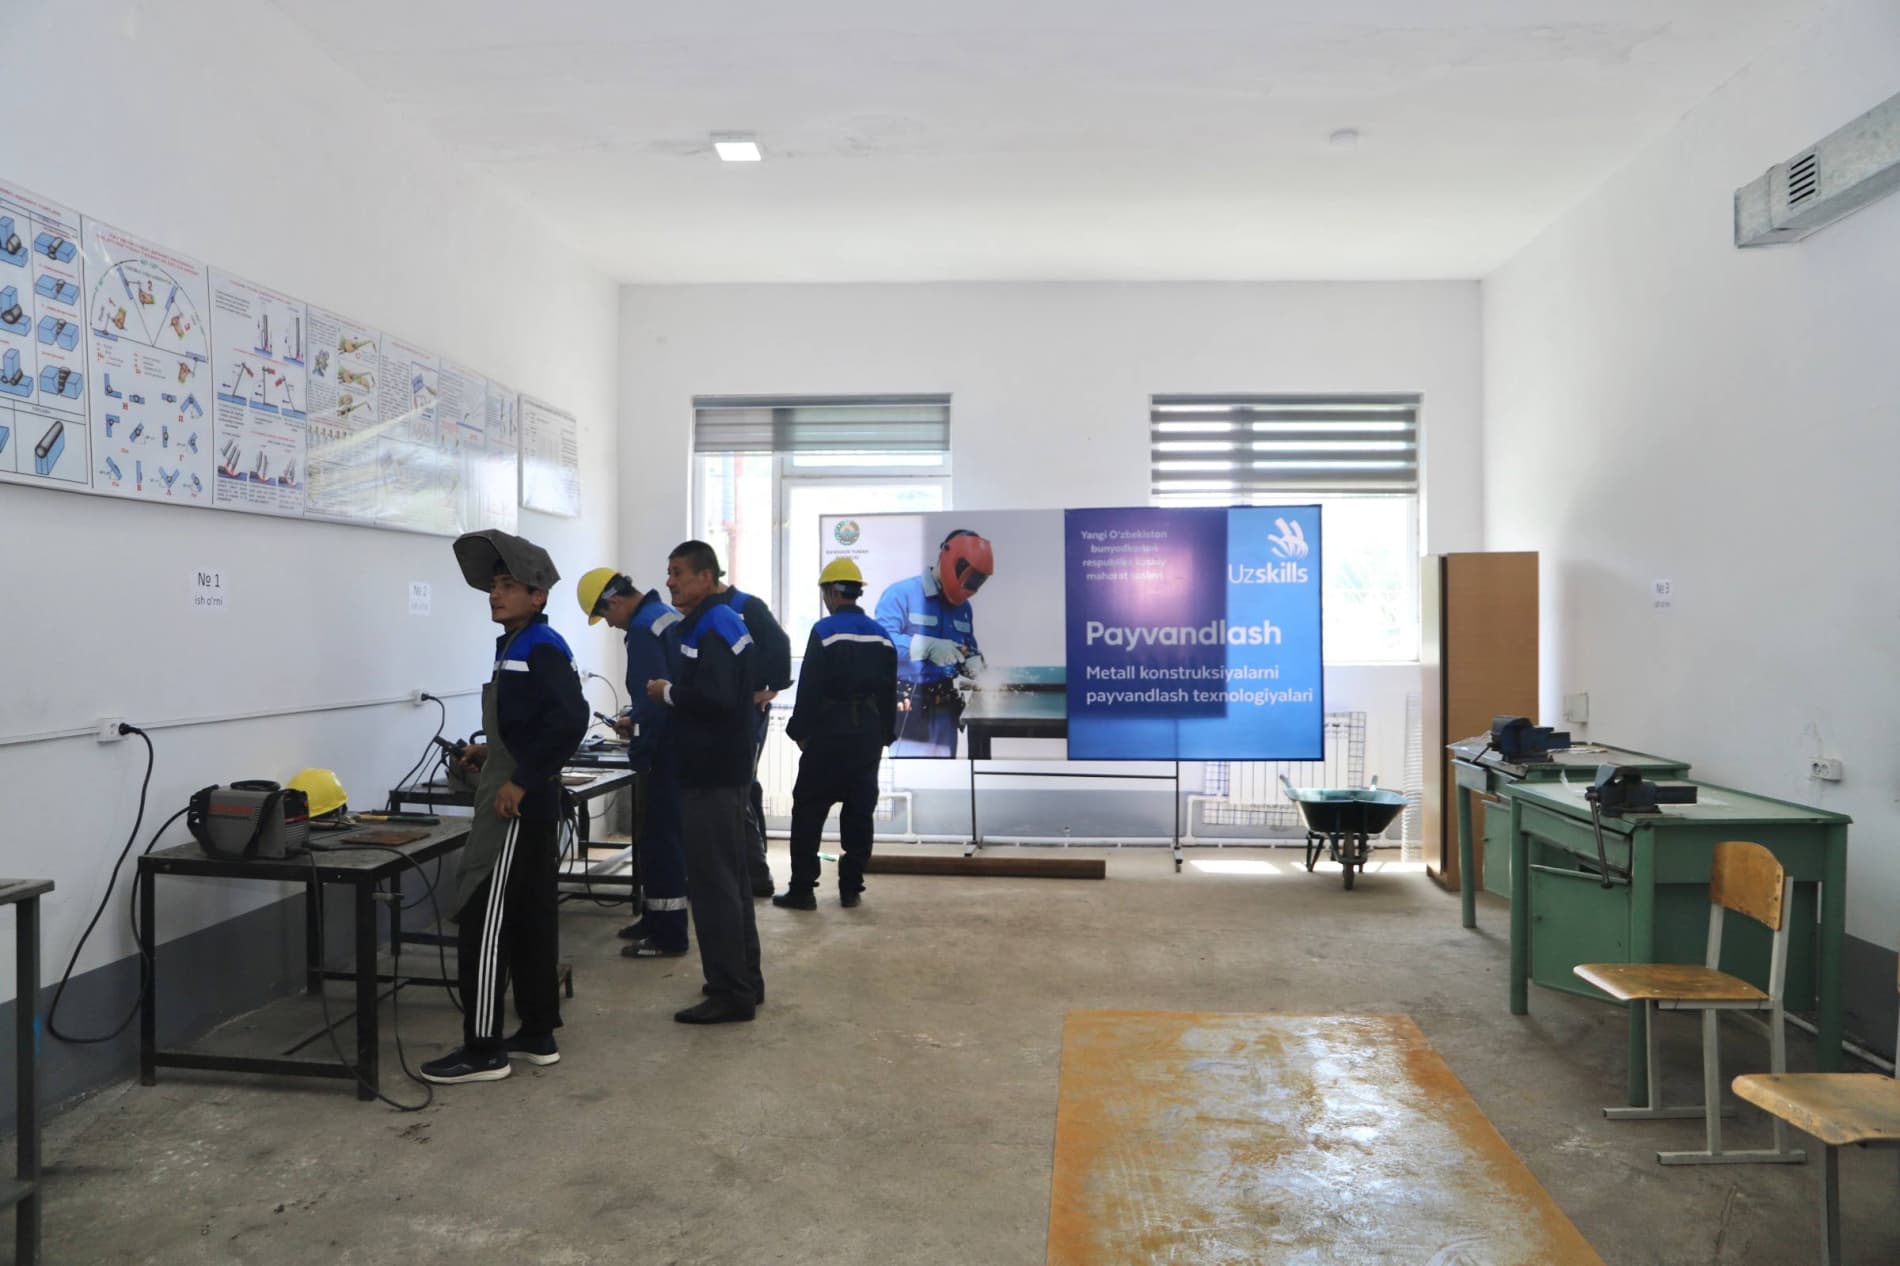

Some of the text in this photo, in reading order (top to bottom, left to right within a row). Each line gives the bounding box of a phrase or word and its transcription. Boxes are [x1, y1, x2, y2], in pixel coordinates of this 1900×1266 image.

[1081, 529, 1108, 541] Yangi
[198, 571, 220, 588] № 1
[1228, 561, 1309, 584] Uzskills
[194, 594, 206, 606] ish
[1086, 620, 1282, 651] Payvandlash
[1086, 665, 1280, 683] Metall konstruksiyalarni
[1086, 688, 1314, 706] payvandlash texnologiyalari
